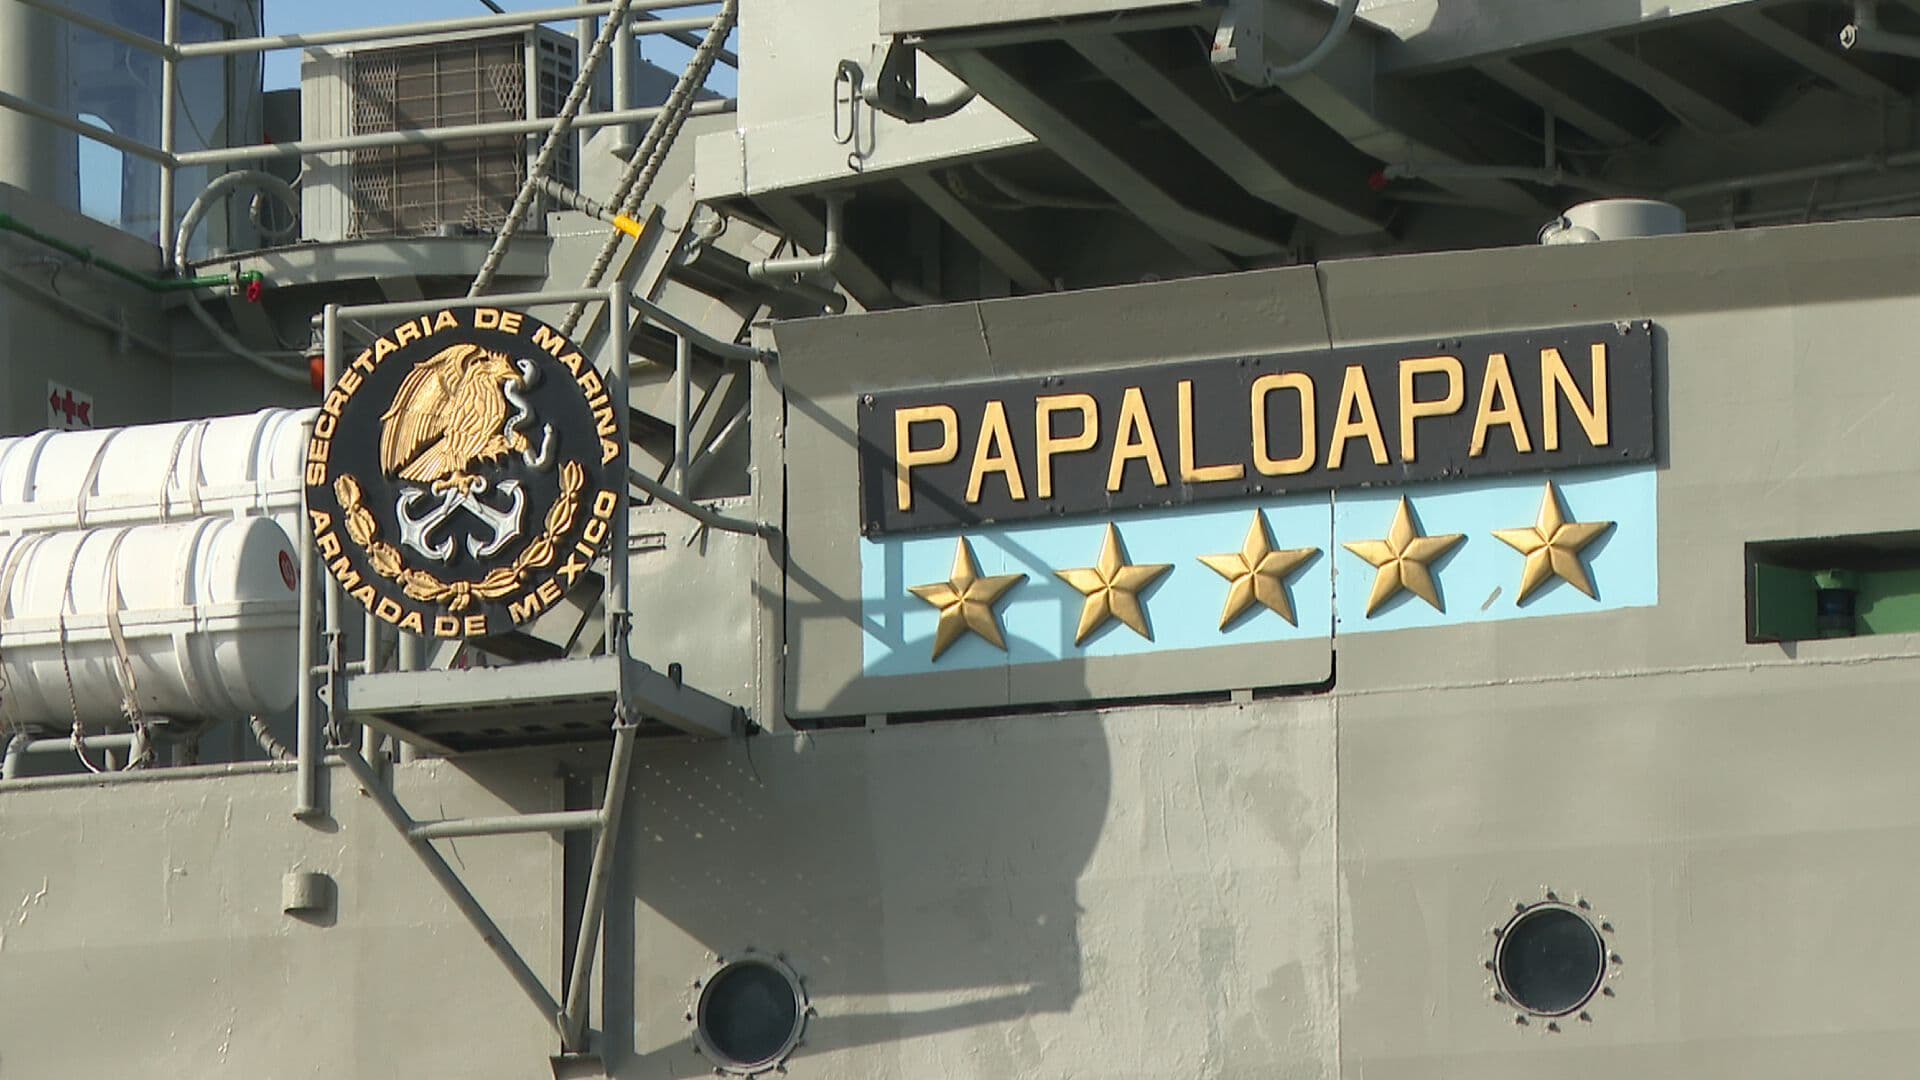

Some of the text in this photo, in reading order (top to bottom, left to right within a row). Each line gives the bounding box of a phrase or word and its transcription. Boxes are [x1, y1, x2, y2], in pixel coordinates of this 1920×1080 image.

[306, 308, 619, 486] SECRETARIA DE MARINA
[895, 343, 1608, 512] PAPALOAPAN
[310, 490, 618, 637] ARMADA DE MEXICO
